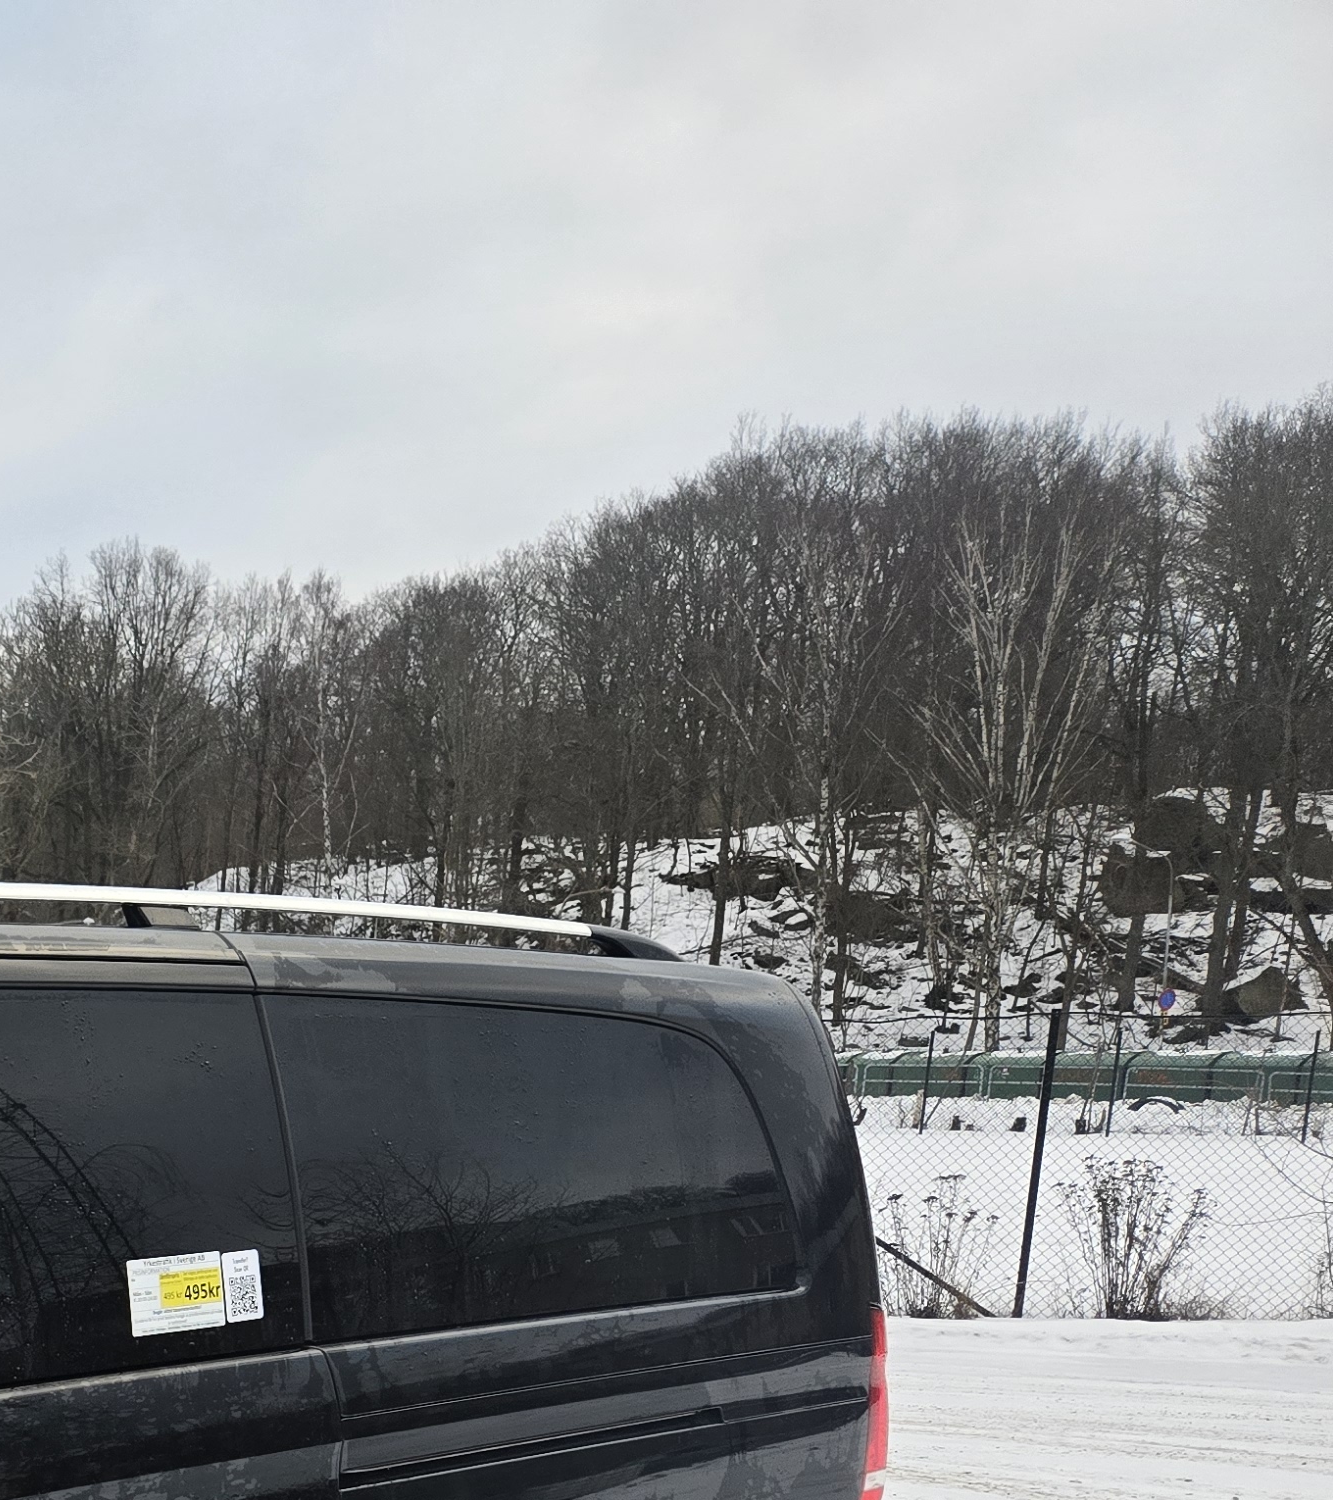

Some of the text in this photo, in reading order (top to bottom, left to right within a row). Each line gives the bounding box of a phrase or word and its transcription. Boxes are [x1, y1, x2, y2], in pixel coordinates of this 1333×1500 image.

[176, 1255, 197, 1265] Sverige
[163, 1292, 175, 1300] 495
[184, 1281, 221, 1301] 495kr
